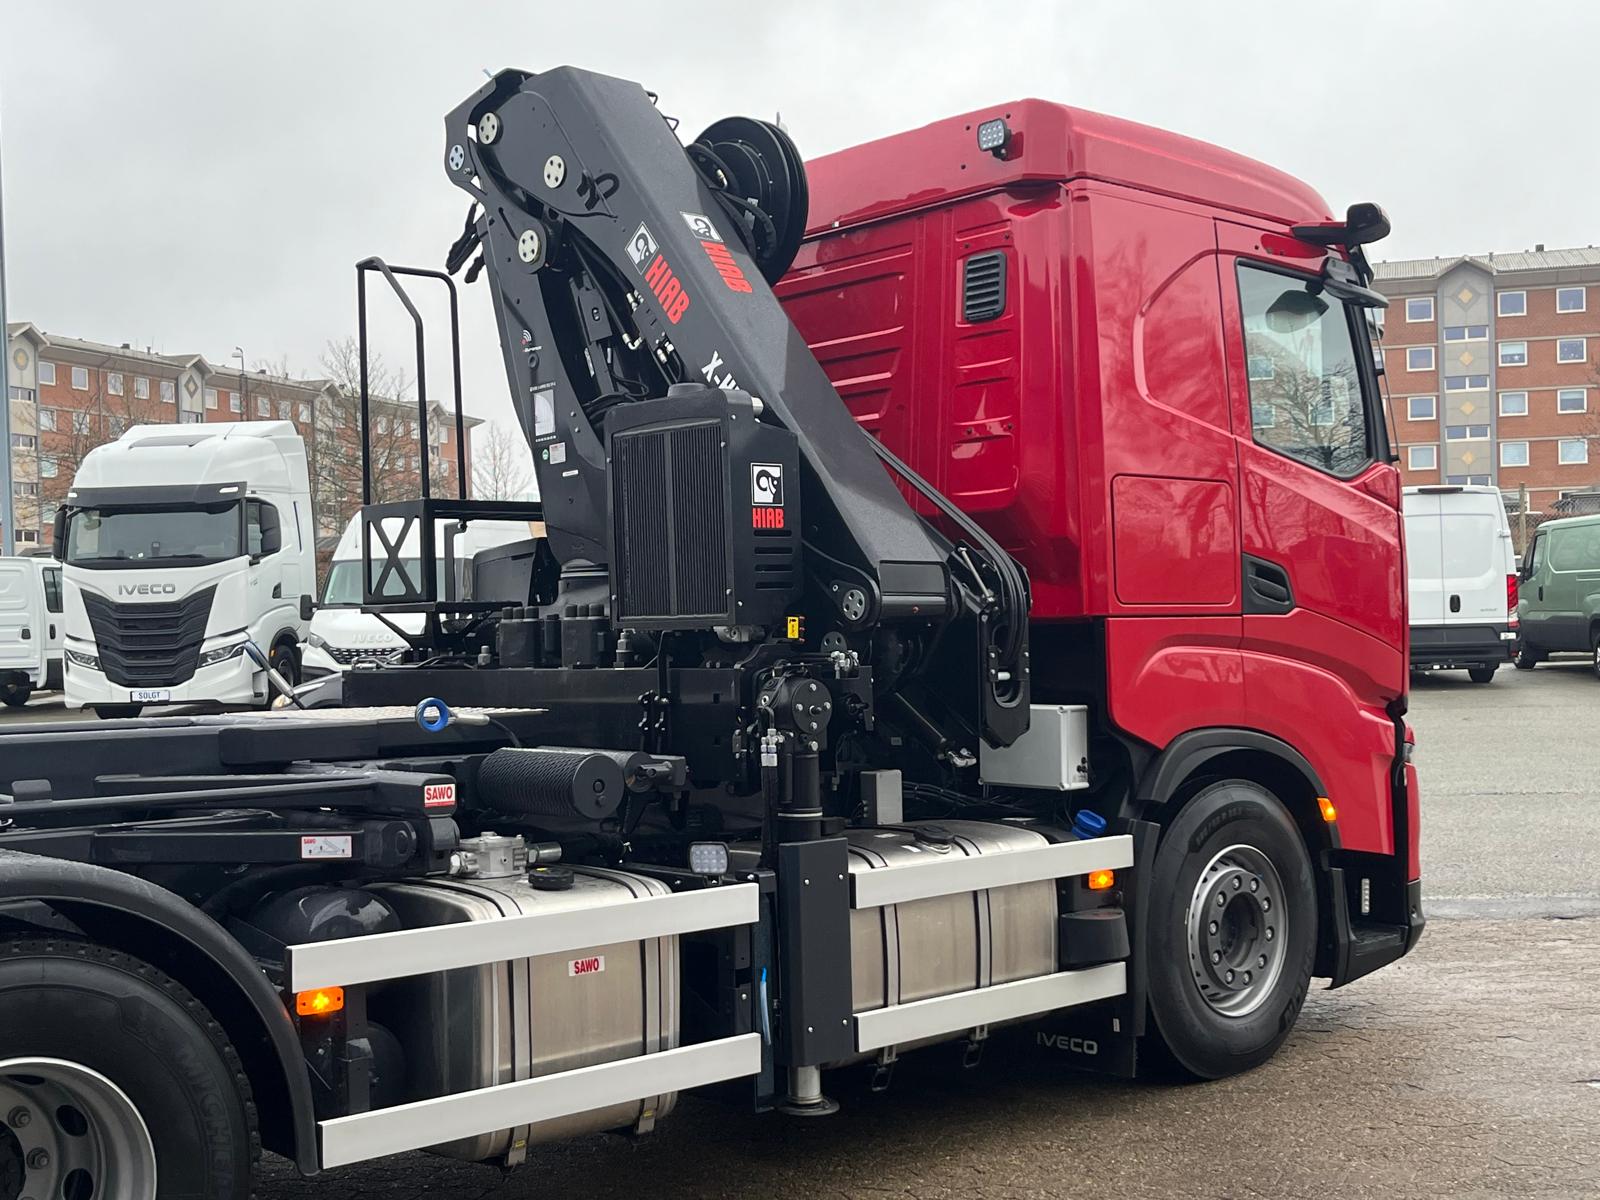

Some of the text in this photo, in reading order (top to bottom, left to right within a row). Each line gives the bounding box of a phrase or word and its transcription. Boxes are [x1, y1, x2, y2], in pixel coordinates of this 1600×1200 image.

[700, 240, 753, 293] HIAB
[644, 253, 690, 325] HIAB
[752, 507, 785, 529] HIAB
[118, 583, 176, 596] IVECO
[351, 631, 393, 644] IVECO
[138, 691, 161, 700] SOLGT
[425, 786, 453, 801] SAWO
[573, 957, 600, 975] SAWO
[1036, 1031, 1098, 1055] IVECO
